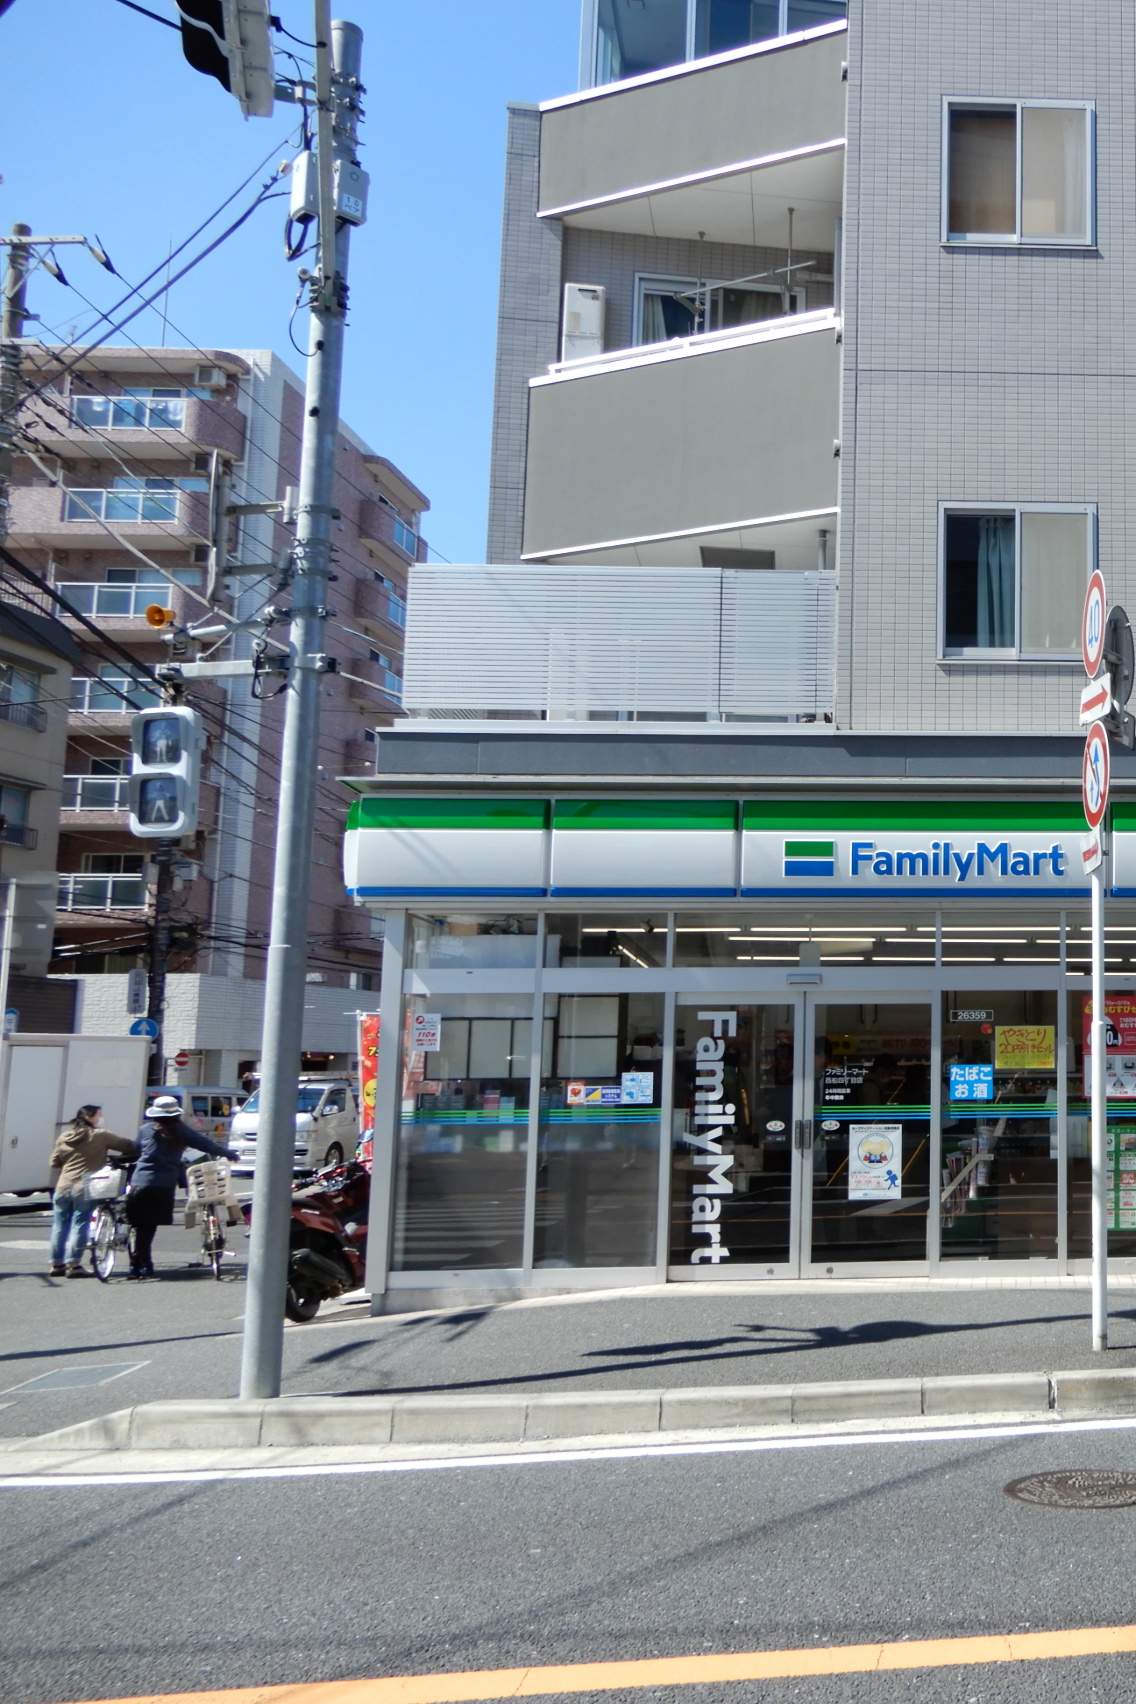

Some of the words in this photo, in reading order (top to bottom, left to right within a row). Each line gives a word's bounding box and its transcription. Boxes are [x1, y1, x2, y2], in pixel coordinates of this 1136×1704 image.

[1088, 599, 1100, 648] 40
[850, 841, 1065, 882] FamilyMart
[957, 1011, 987, 1020] 26359
[1000, 1028, 1046, 1045] やきとり
[950, 1066, 992, 1081] たばこ
[955, 1083, 988, 1098] お酒
[683, 1011, 737, 1264] FamilyMart
